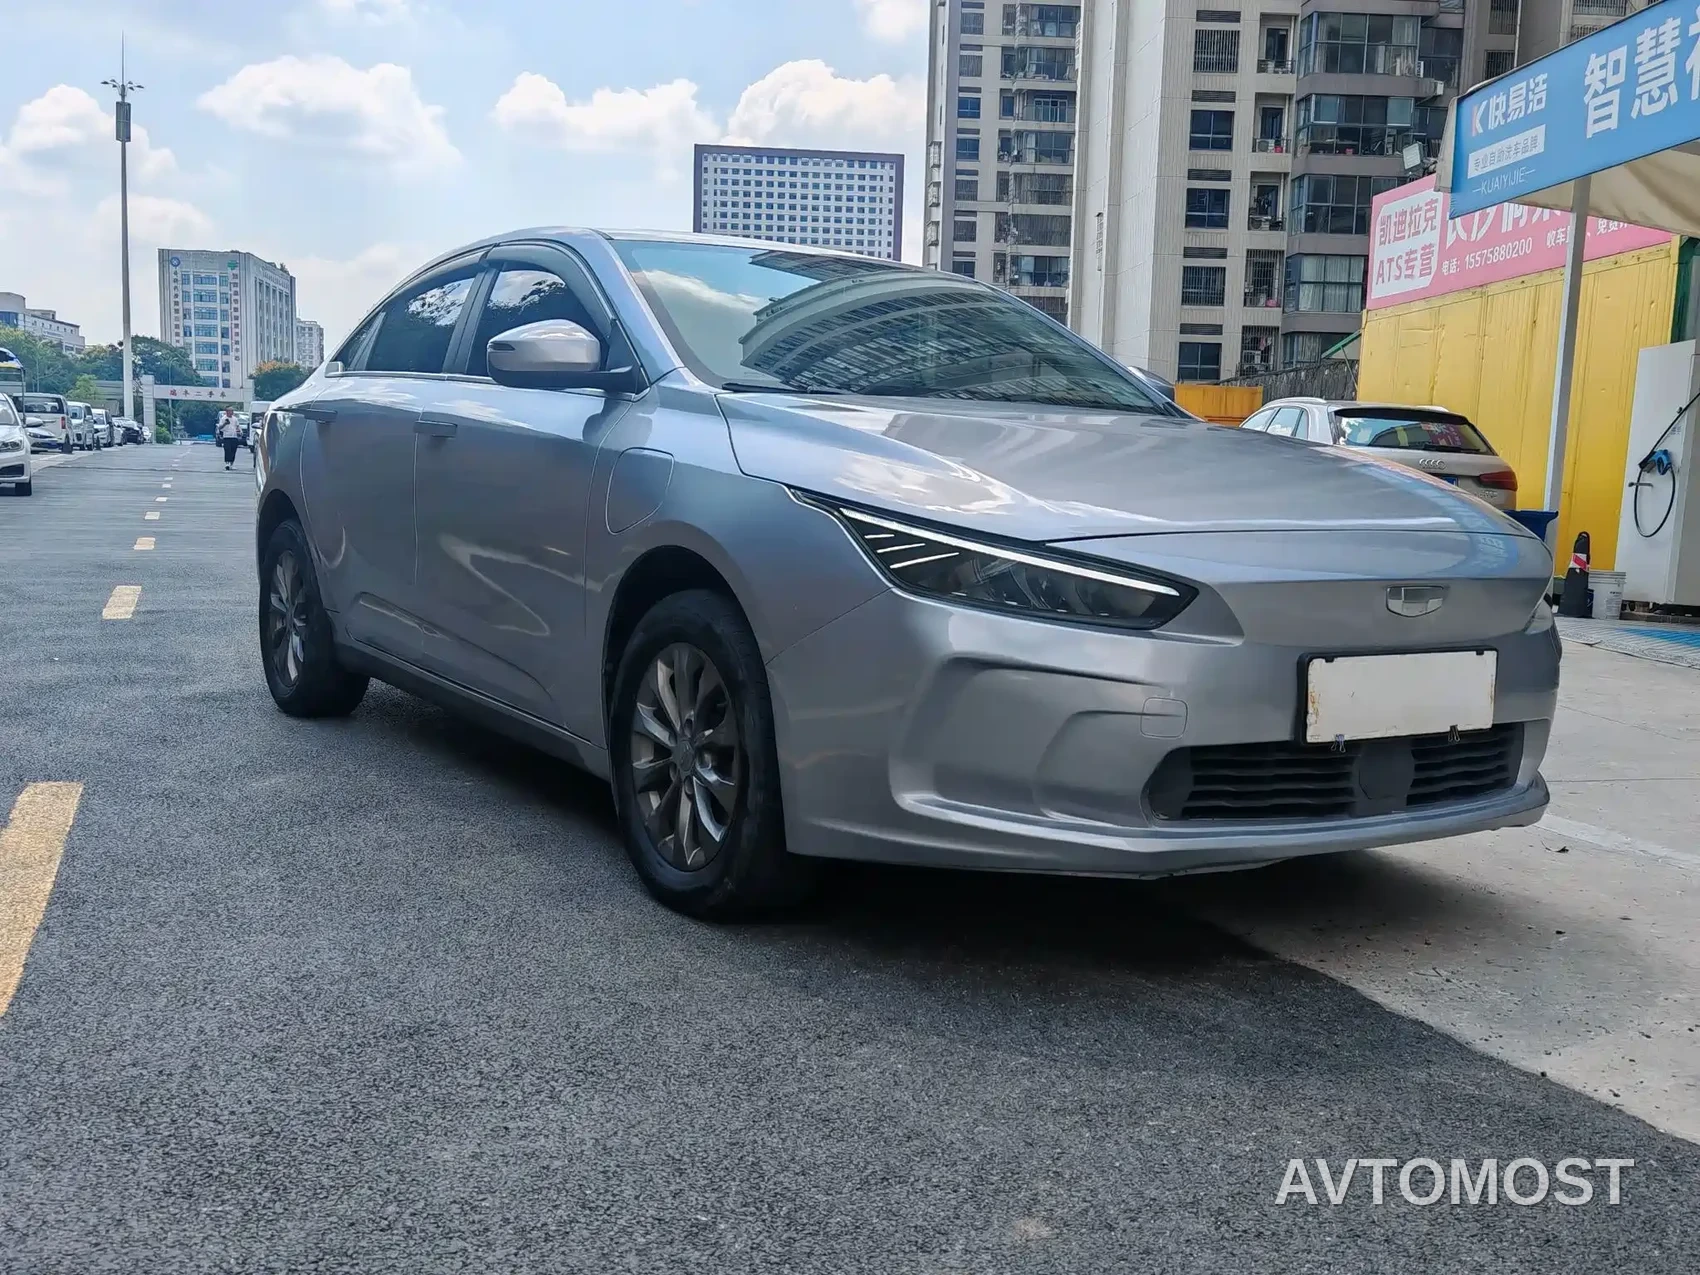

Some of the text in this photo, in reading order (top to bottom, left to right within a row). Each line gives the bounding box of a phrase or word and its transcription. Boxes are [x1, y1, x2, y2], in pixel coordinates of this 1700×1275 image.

[1379, 198, 1439, 247] 凯迪拉克
[1376, 243, 1435, 286] ATS专营
